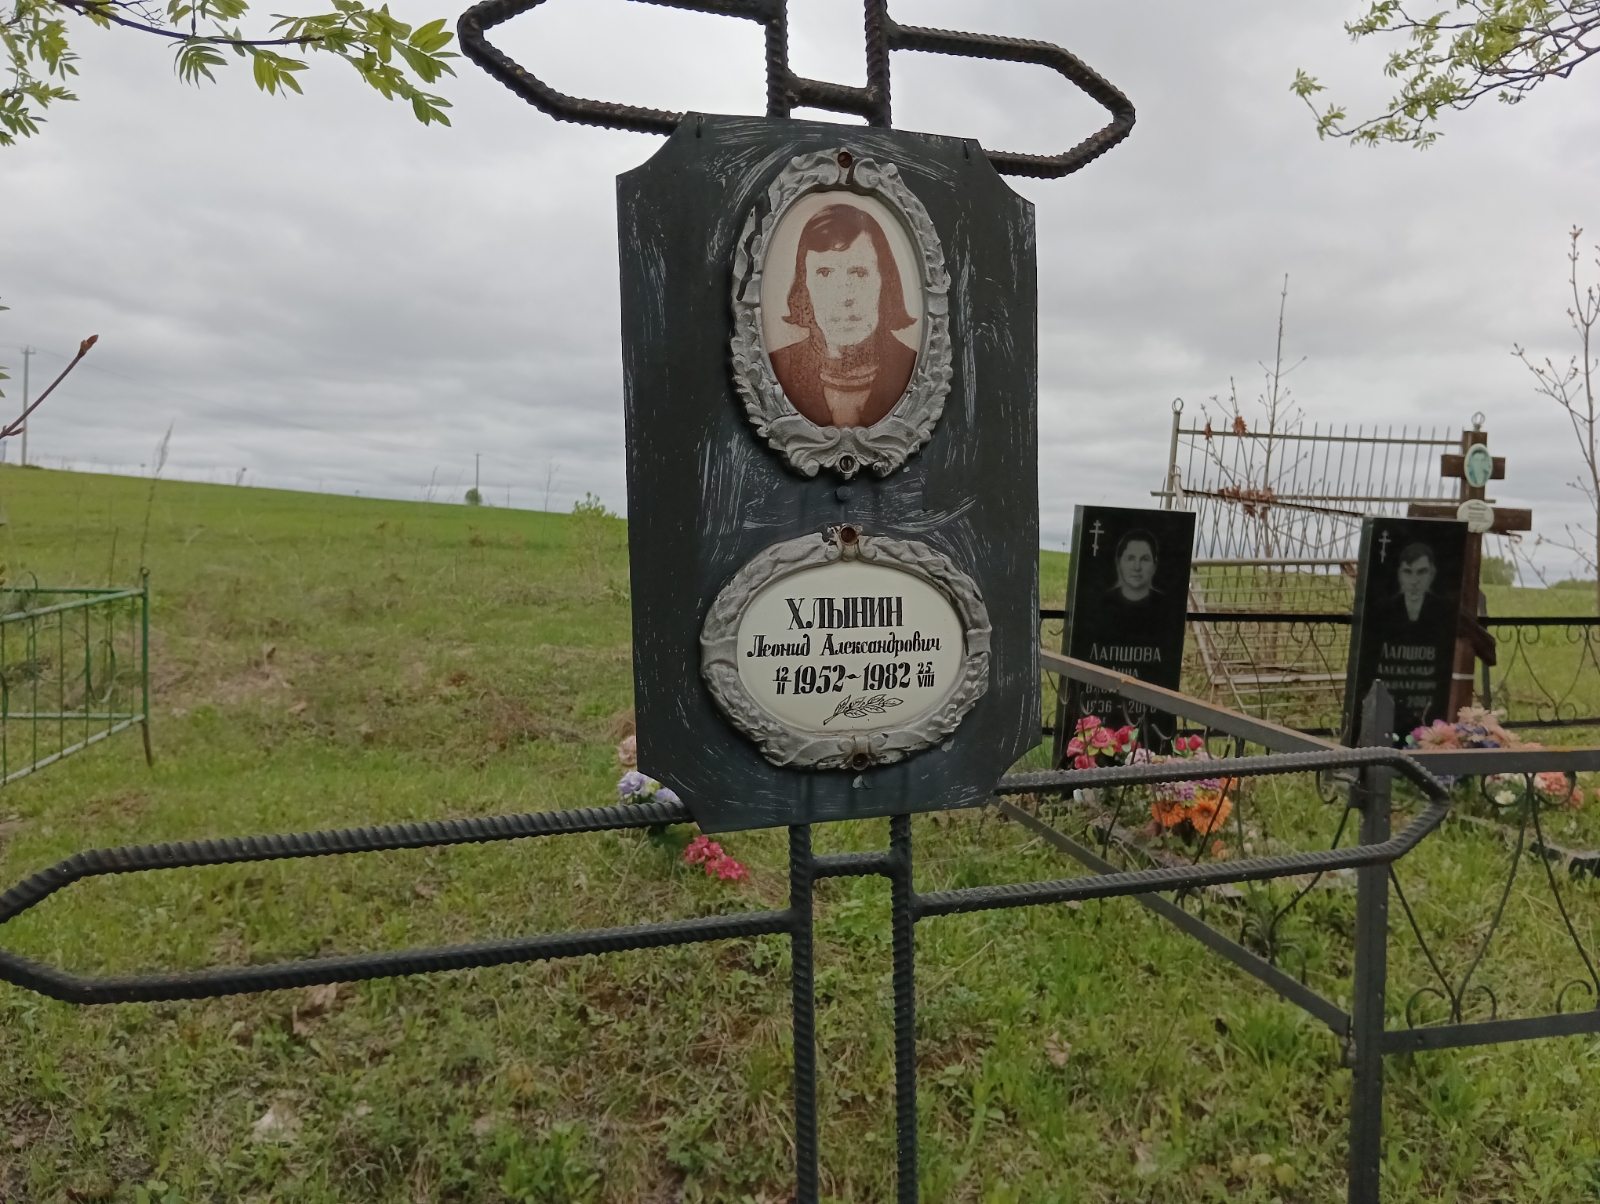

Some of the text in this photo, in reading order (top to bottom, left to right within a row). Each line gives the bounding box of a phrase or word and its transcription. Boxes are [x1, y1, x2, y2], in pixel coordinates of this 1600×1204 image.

[785, 596, 904, 630] ХЛЫНИН
[747, 630, 942, 658] Леонид Александрович
[1089, 642, 1162, 662] ЛАПШОВА
[775, 666, 789, 680] 12
[916, 661, 933, 674] 25
